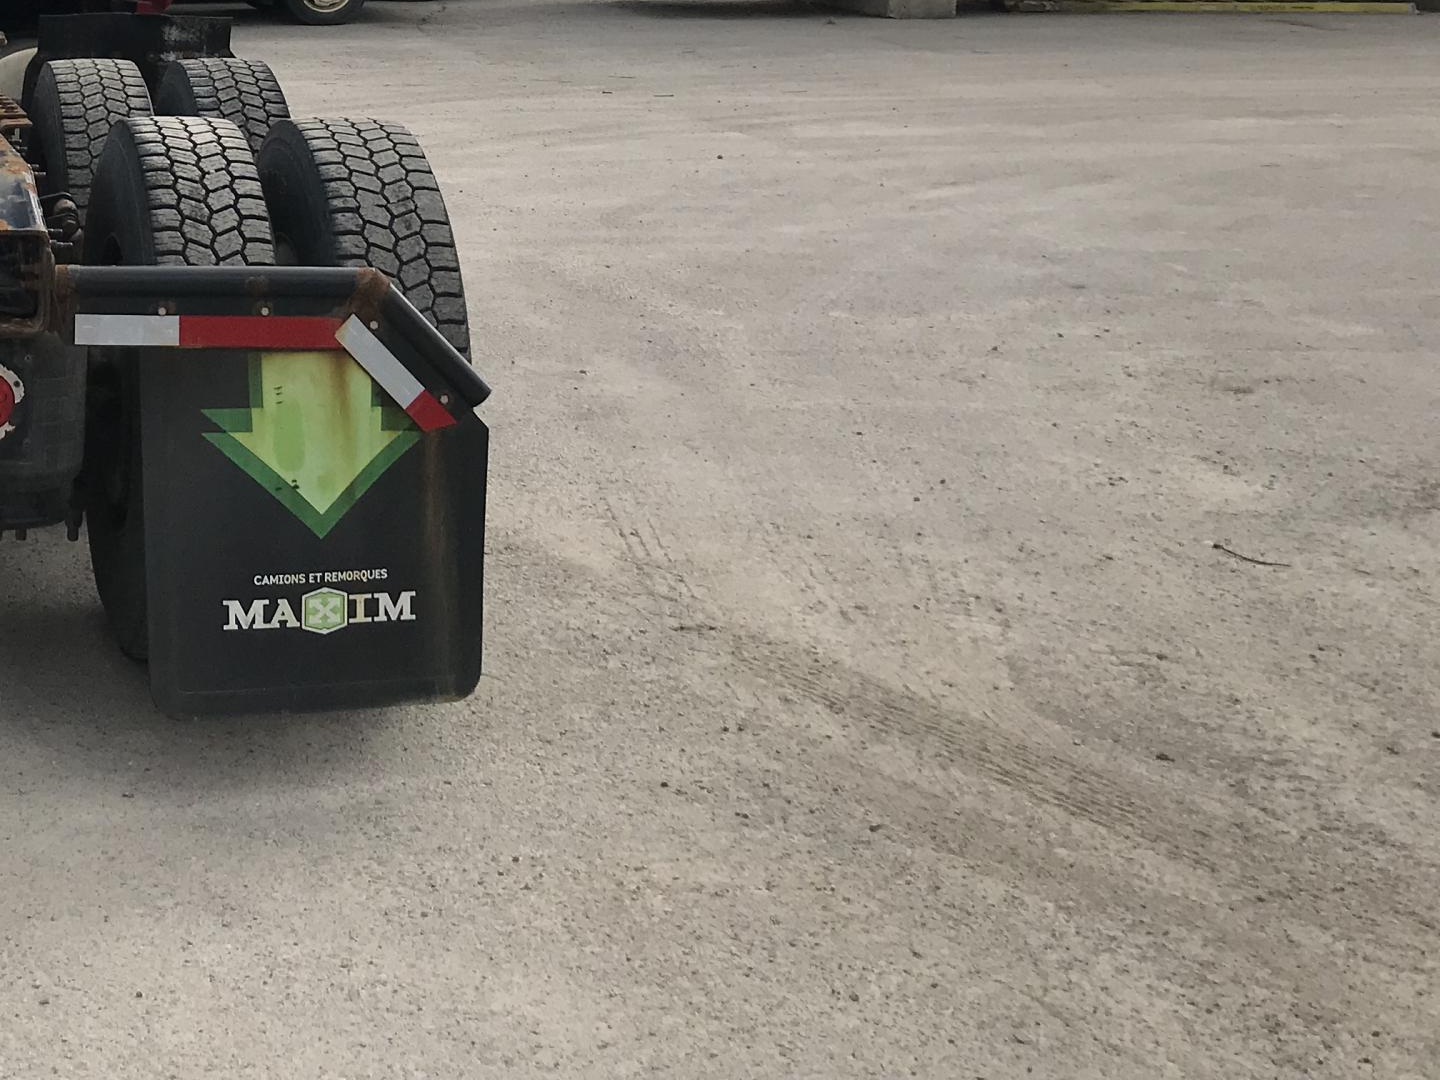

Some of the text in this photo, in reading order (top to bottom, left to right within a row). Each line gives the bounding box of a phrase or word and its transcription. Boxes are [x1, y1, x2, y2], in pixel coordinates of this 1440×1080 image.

[254, 568, 388, 586] CAMIONS ET REMORQUES
[222, 587, 417, 634] MAXIM
